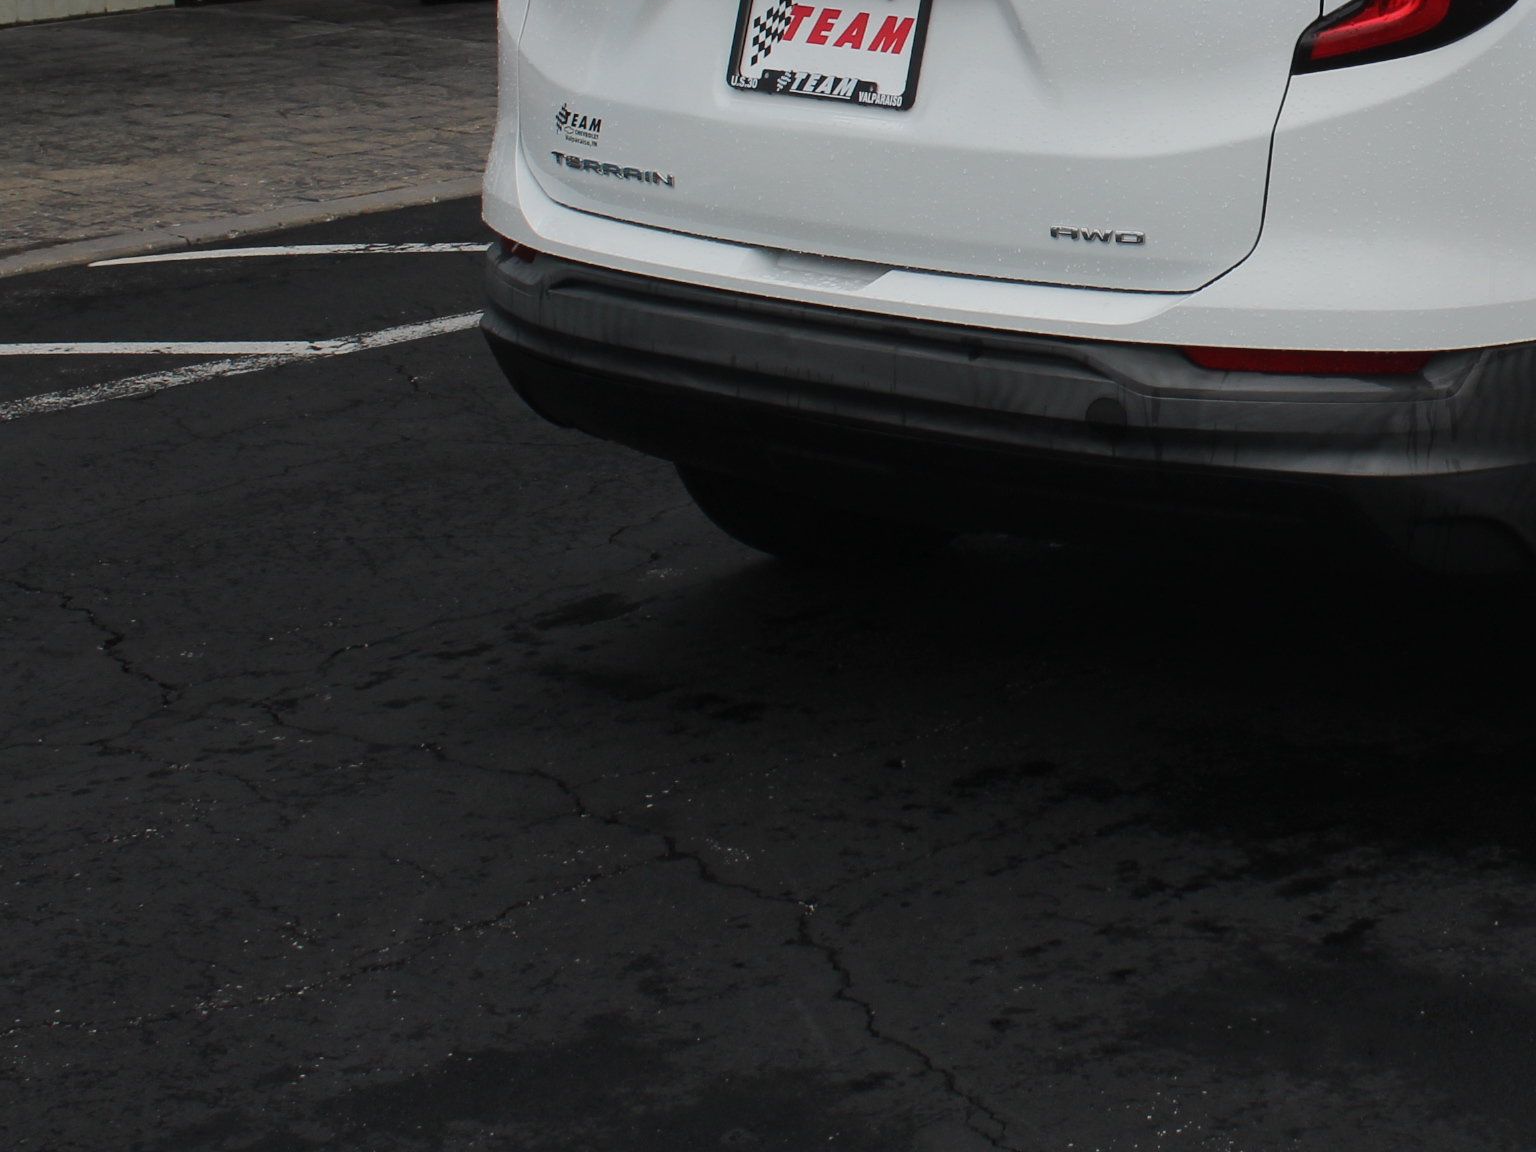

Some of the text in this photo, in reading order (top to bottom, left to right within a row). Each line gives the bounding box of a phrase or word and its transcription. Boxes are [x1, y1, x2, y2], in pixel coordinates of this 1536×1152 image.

[783, 3, 915, 54] TEAM
[789, 71, 858, 98] TEAM
[858, 91, 903, 107] VALPARAISO
[562, 110, 602, 133] TEAM
[551, 150, 676, 188] TERRAIN
[1050, 225, 1145, 244] AWD
